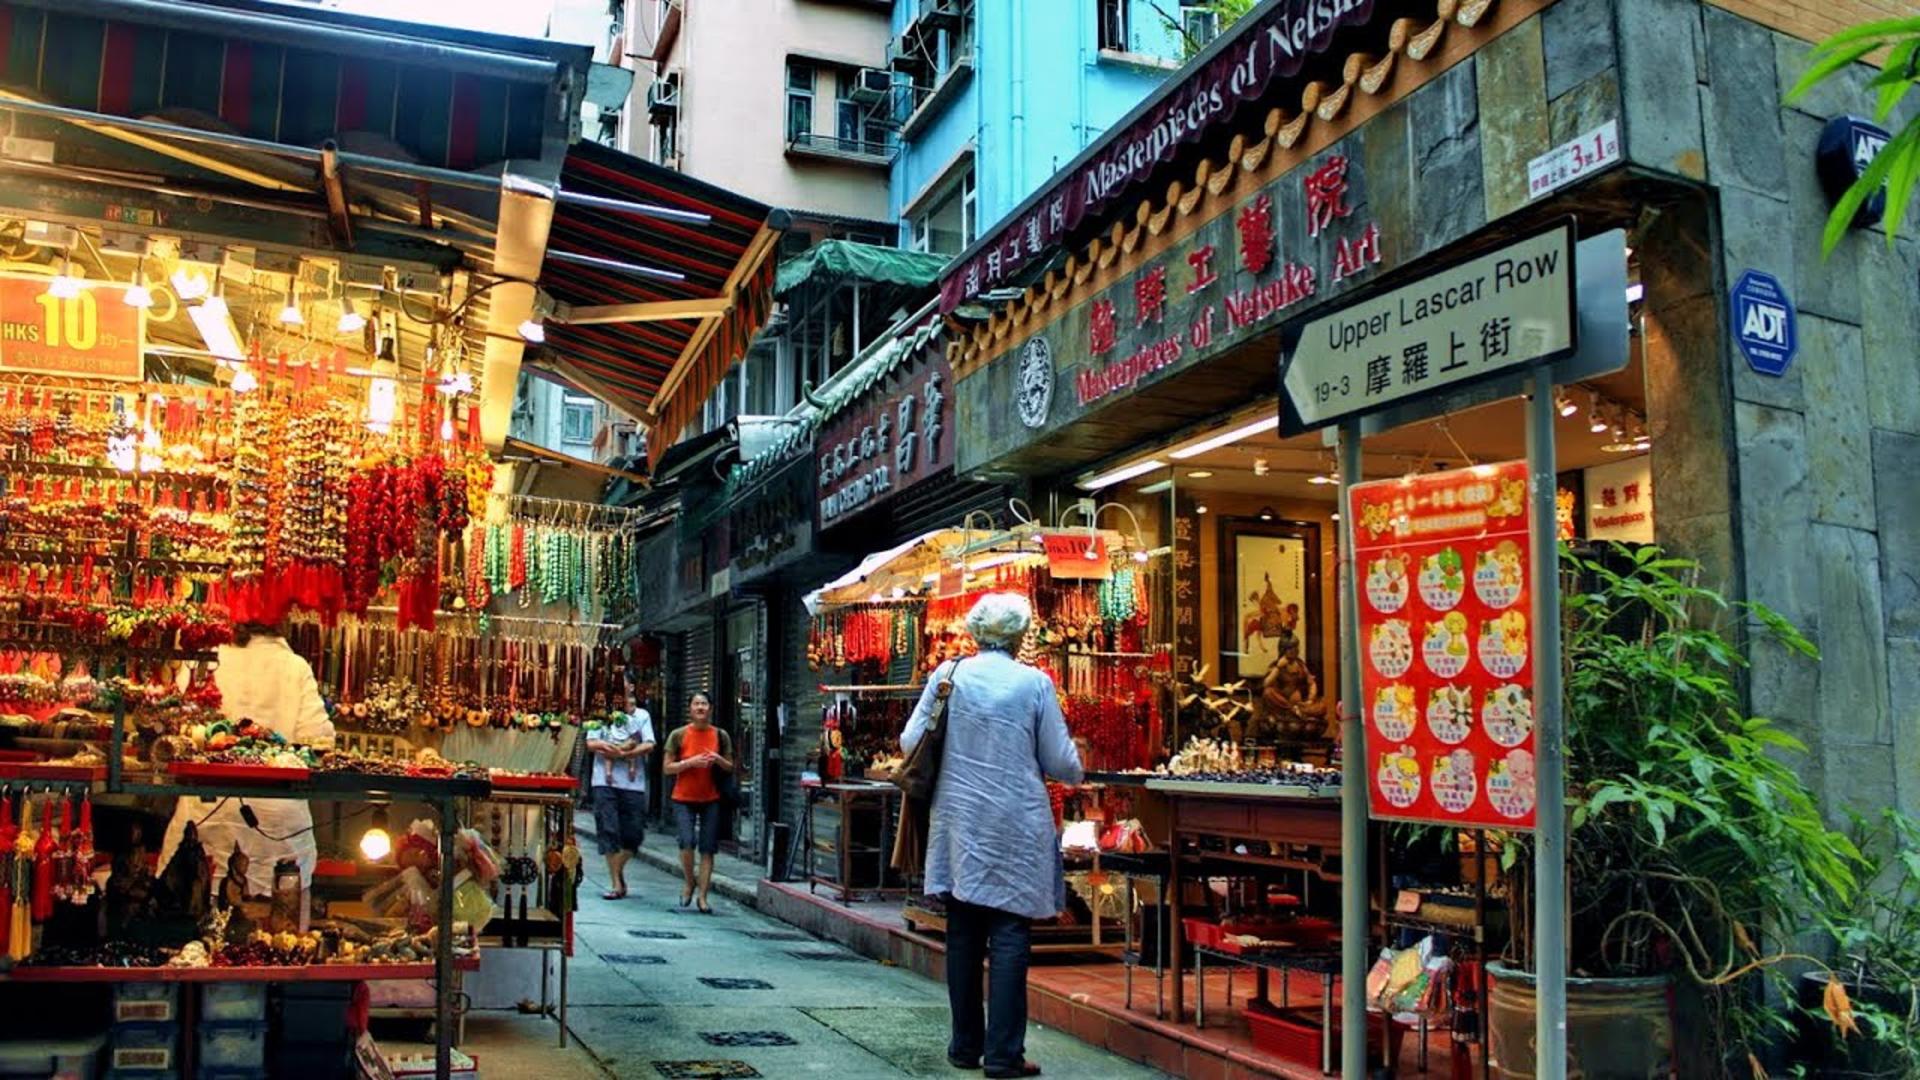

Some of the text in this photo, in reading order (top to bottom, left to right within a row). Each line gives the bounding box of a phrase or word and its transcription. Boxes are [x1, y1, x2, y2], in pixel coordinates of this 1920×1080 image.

[1085, 80, 1224, 205] Masterpieces
[1231, 40, 1257, 95] of
[1854, 133, 1889, 165] AD
[35, 286, 97, 351] 10
[1075, 221, 1382, 407] Masterpieces of Netsuke Art
[1328, 249, 1559, 353] Upper Lascar Row
[1742, 303, 1787, 344] ADT
[1314, 374, 1350, 403] 19-3
[1365, 316, 1511, 397] 摩羅上街
